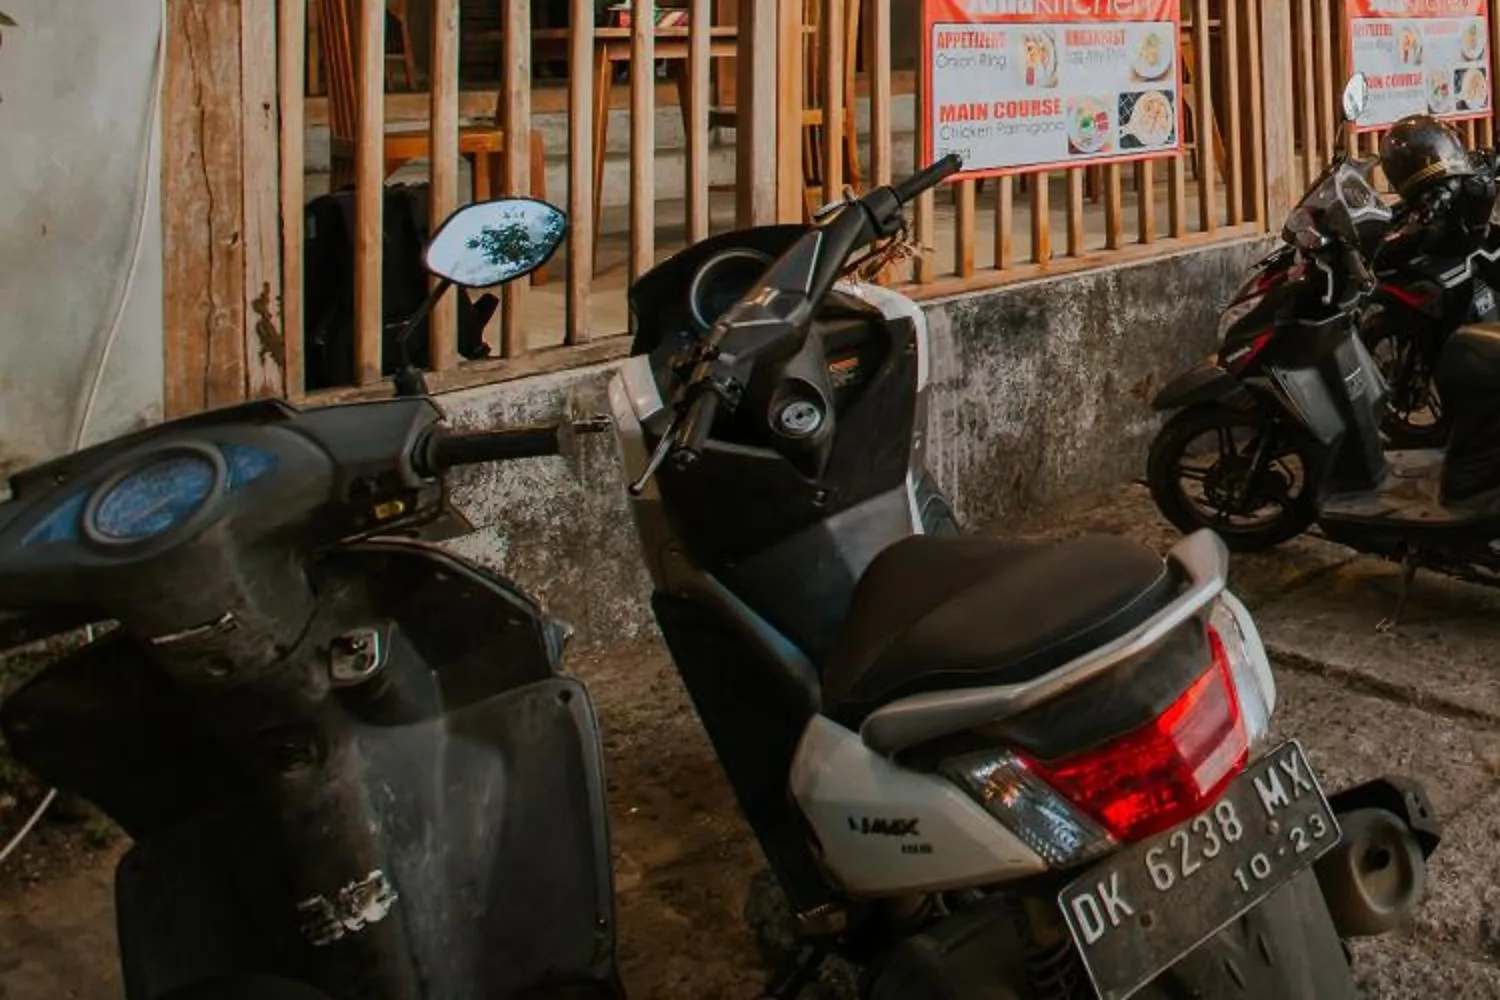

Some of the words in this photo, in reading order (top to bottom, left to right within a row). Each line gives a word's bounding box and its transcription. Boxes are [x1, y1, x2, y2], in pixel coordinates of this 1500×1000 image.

[940, 103, 988, 122] MAIN
[994, 98, 1061, 119] COURSE
[1072, 871, 1136, 944] DK
[1145, 800, 1244, 892] 6238
[1253, 750, 1312, 816] MX
